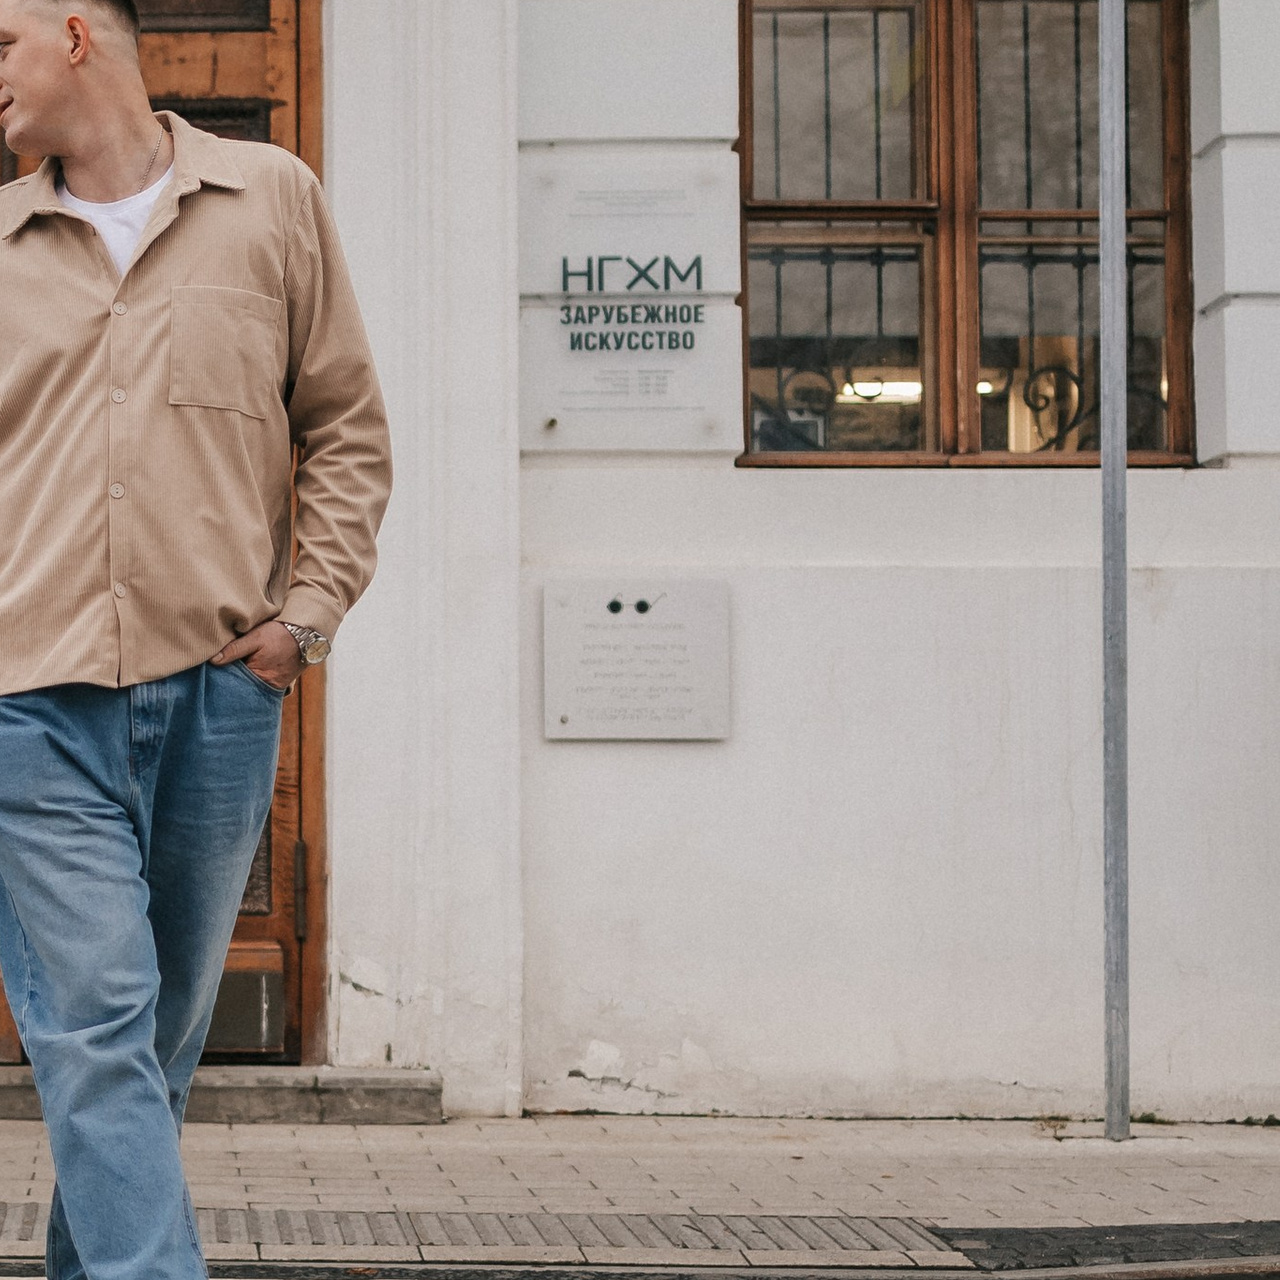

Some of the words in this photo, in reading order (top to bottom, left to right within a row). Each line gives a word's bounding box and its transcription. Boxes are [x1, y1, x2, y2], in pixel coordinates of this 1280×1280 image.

[561, 255, 702, 292] НГХМ
[559, 303, 706, 325] ЗАРУБЕЖНОЕ
[569, 329, 696, 351] ИСКУССТВО
